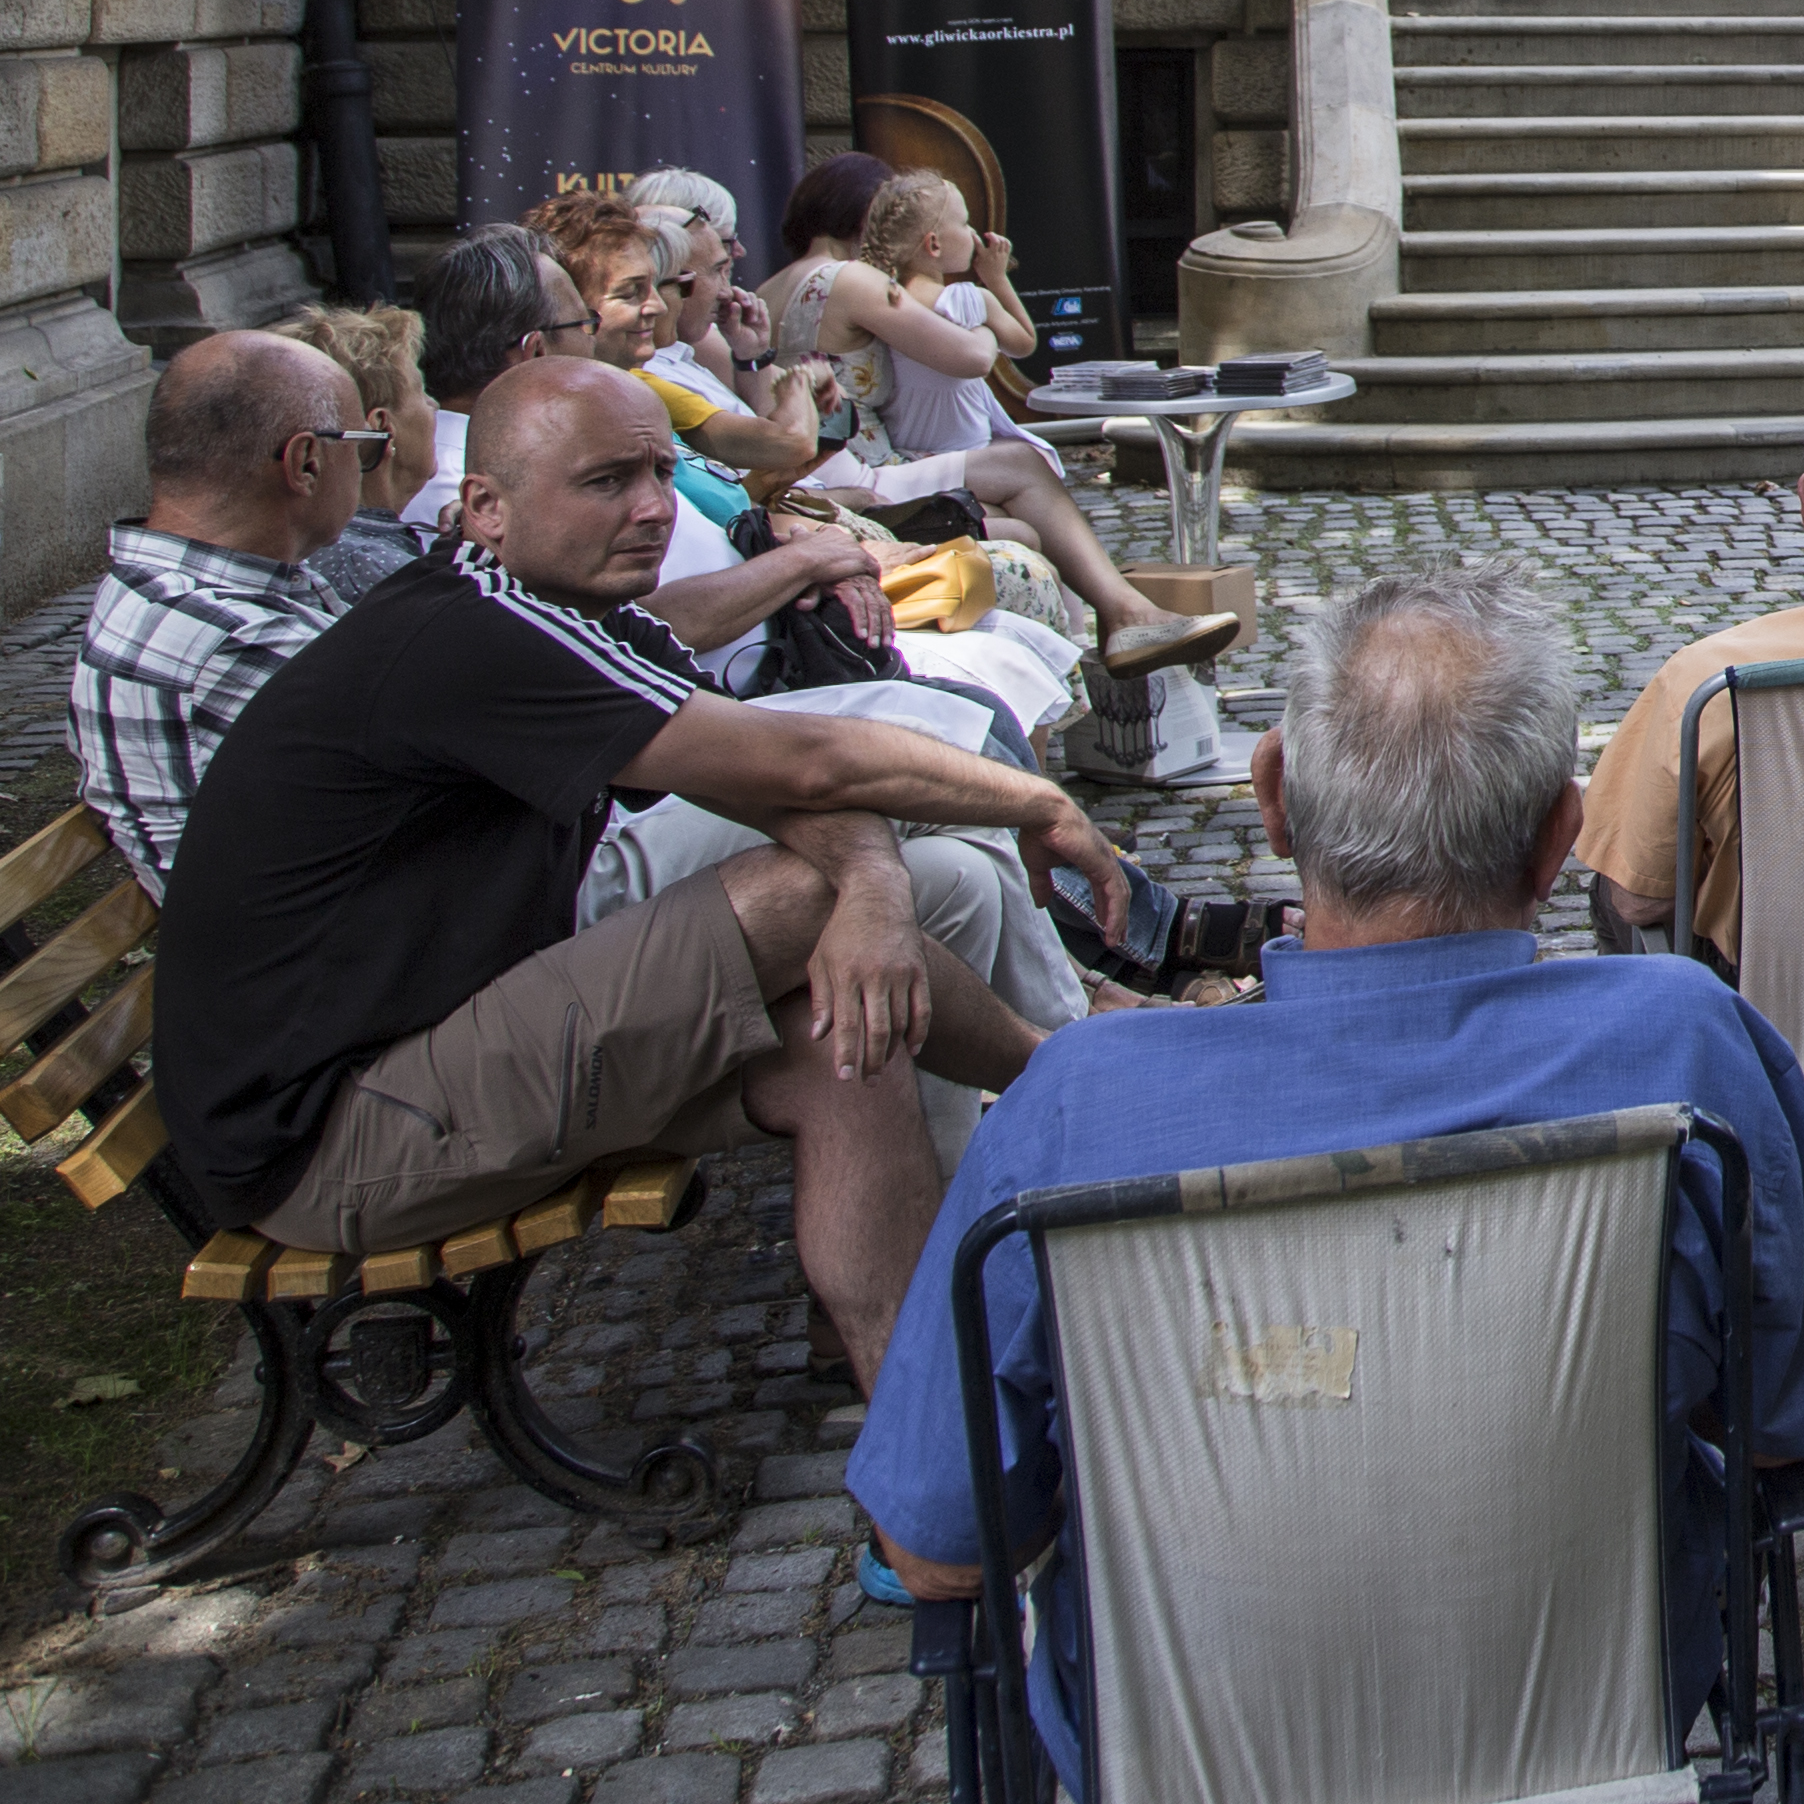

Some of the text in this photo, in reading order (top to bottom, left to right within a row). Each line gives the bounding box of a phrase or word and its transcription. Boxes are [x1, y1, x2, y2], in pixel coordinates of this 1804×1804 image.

[552, 27, 715, 57] VICTORIA
[886, 23, 1074, 47] www.gliwickaorkiestra.pl
[570, 62, 698, 76] CENTRUM KULTURY
[585, 1044, 604, 1130] SALOMON
